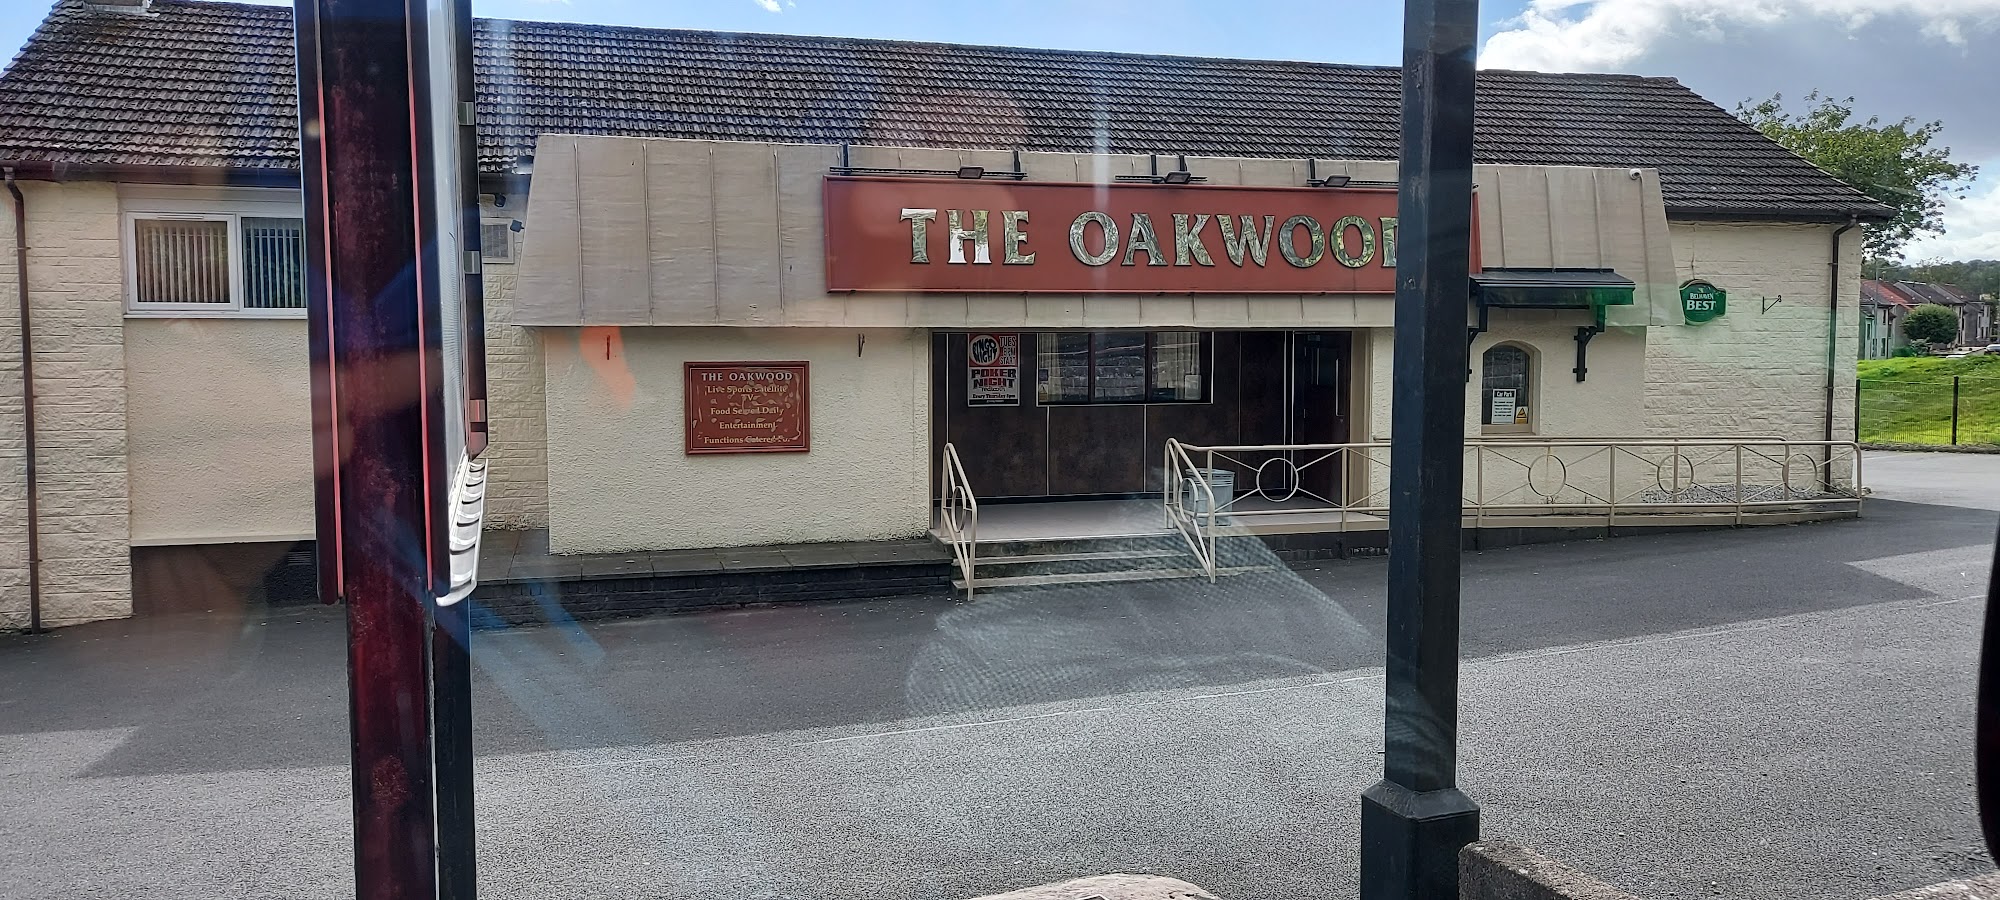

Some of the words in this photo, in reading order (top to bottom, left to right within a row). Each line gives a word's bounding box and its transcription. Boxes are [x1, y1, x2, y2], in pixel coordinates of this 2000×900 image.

[899, 207, 1037, 266] THE
[1686, 300, 1716, 310] BEST
[999, 336, 1016, 347] TUES
[999, 356, 1016, 365] START
[701, 372, 724, 381] THE
[728, 372, 793, 381] OAKWOOD
[972, 368, 1016, 378] POKER
[973, 378, 1015, 389] NIGHT
[707, 385, 725, 393] Live
[726, 385, 753, 396] Sports
[710, 407, 731, 415] Food
[719, 420, 777, 430] Entertainment
[704, 435, 744, 444] Functions
